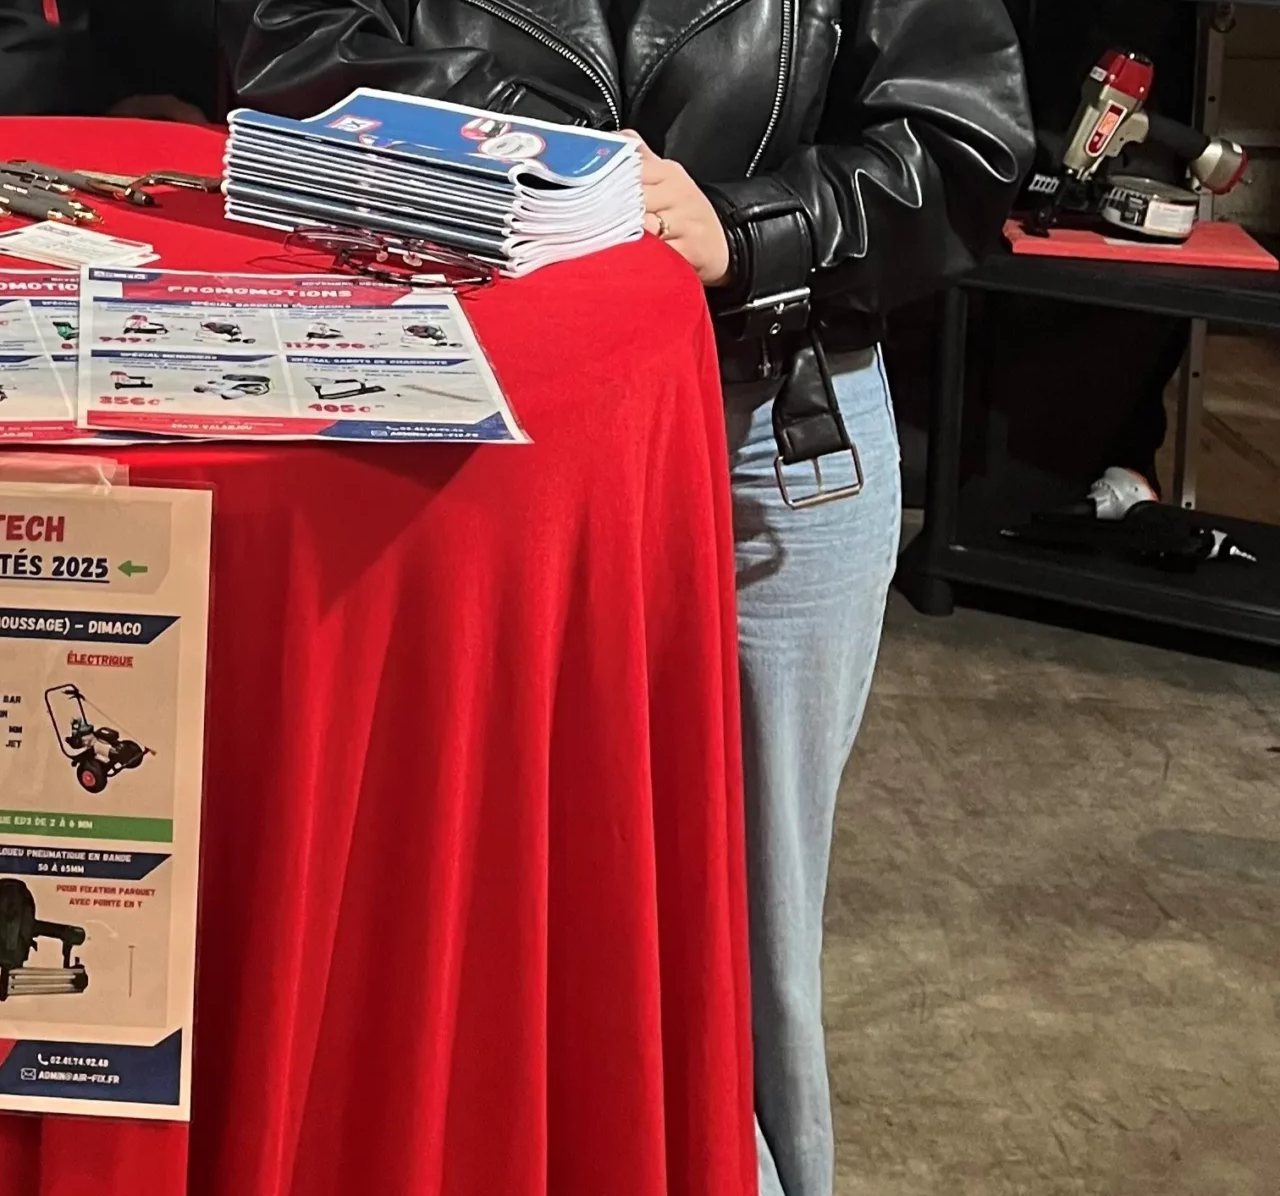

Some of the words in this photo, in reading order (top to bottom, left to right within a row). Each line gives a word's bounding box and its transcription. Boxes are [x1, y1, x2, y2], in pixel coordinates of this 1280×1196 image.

[168, 286, 352, 298] PROMOMOTIONS
[52, 556, 108, 578] 2025
[88, 620, 142, 636] DIMACO
[67, 650, 134, 666] ÉLECTRIQUE
[3, 695, 21, 704] BAR
[6, 740, 22, 748] JET
[35, 817, 47, 826] DE
[26, 848, 86, 860] PNEUMATIQUE
[88, 853, 100, 861] EN
[102, 853, 132, 863] BANDE
[56, 884, 78, 892] POUR
[118, 888, 156, 896] PARQUET
[69, 898, 91, 906] AVEC
[93, 899, 121, 908] POINTE
